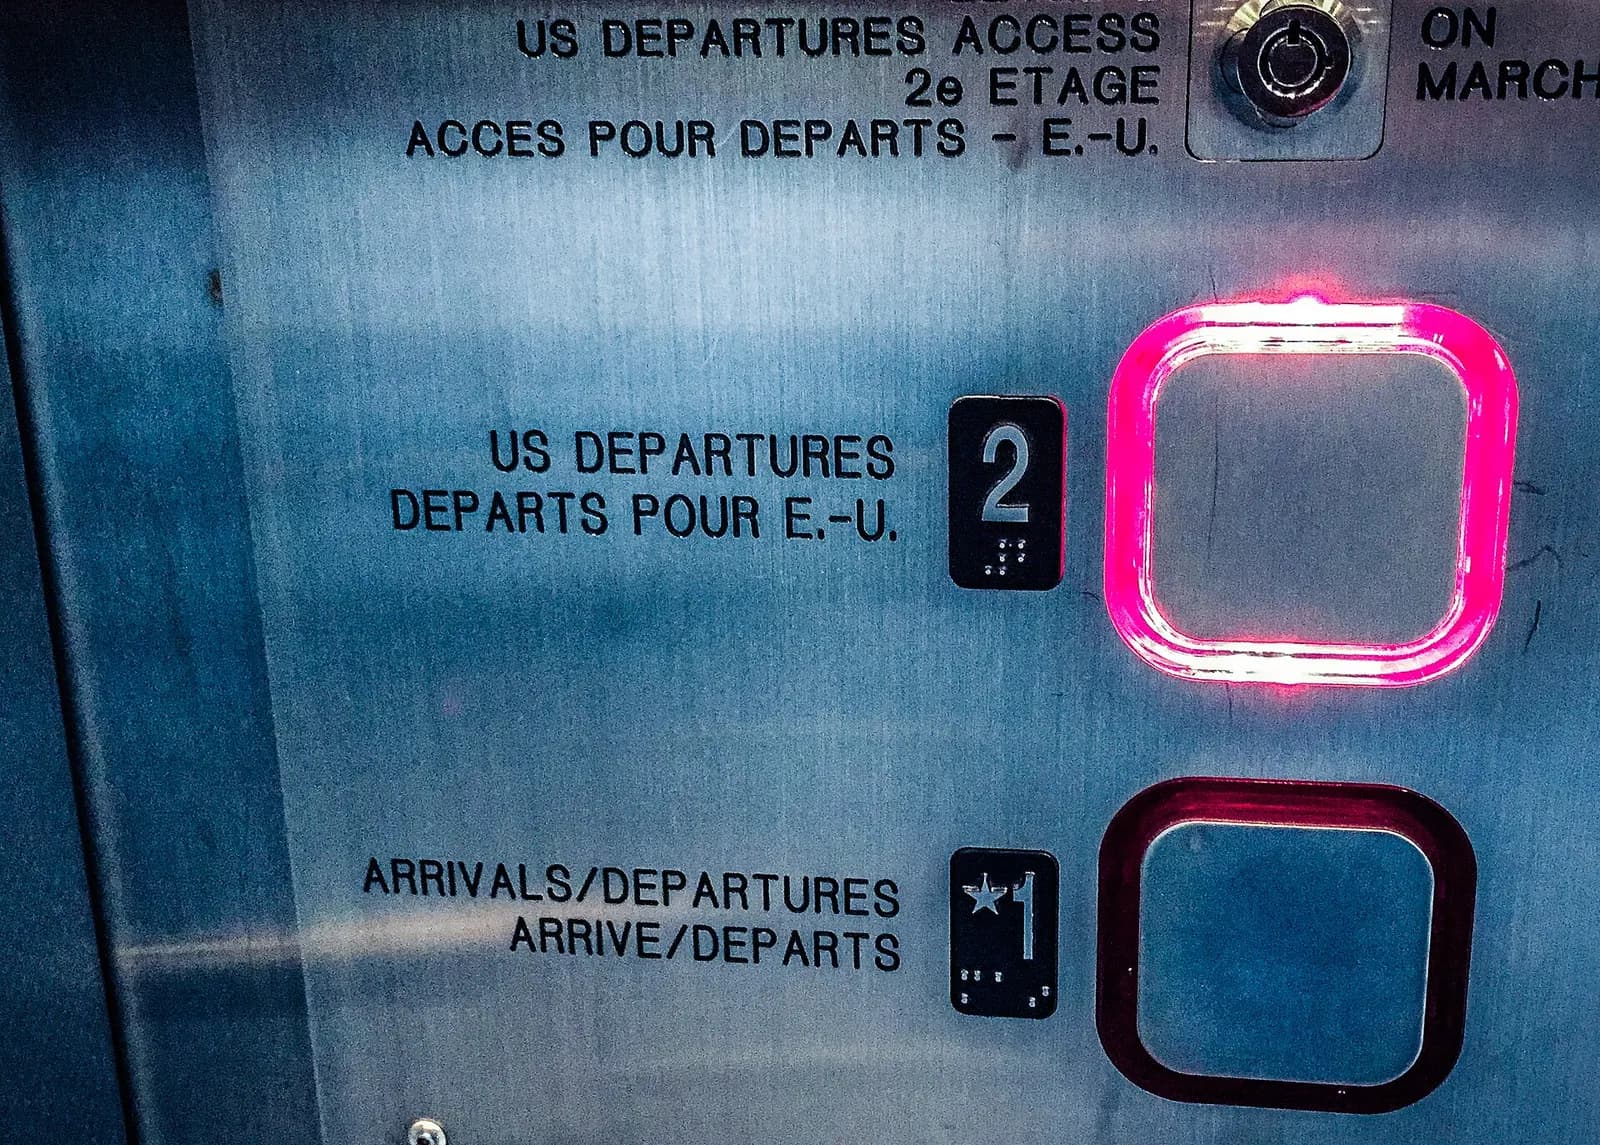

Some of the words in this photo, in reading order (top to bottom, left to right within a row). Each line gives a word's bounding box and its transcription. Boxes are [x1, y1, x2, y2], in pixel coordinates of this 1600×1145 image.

[516, 18, 579, 59] US
[602, 15, 926, 59] DEPARTURES
[951, 12, 1161, 56] ACCESS
[1421, 6, 1497, 49] ON
[904, 67, 964, 107] 2e
[989, 65, 1161, 107] ETAGE
[1416, 59, 1600, 101] MARCH
[405, 119, 566, 159] ACCES
[588, 118, 717, 159] POUR
[740, 117, 967, 158] DEPARTS
[1042, 117, 1159, 157] E.-U.
[489, 429, 551, 474] US
[575, 430, 896, 481] DEPARTURES
[981, 424, 1030, 523] 2
[391, 488, 608, 536] DEPARTS
[633, 493, 761, 540] POUR
[785, 496, 899, 542] E.-U.
[363, 857, 901, 918] ARRIVALS/DEPARTURES
[509, 916, 901, 972] ARRIVE/DEPARTS
